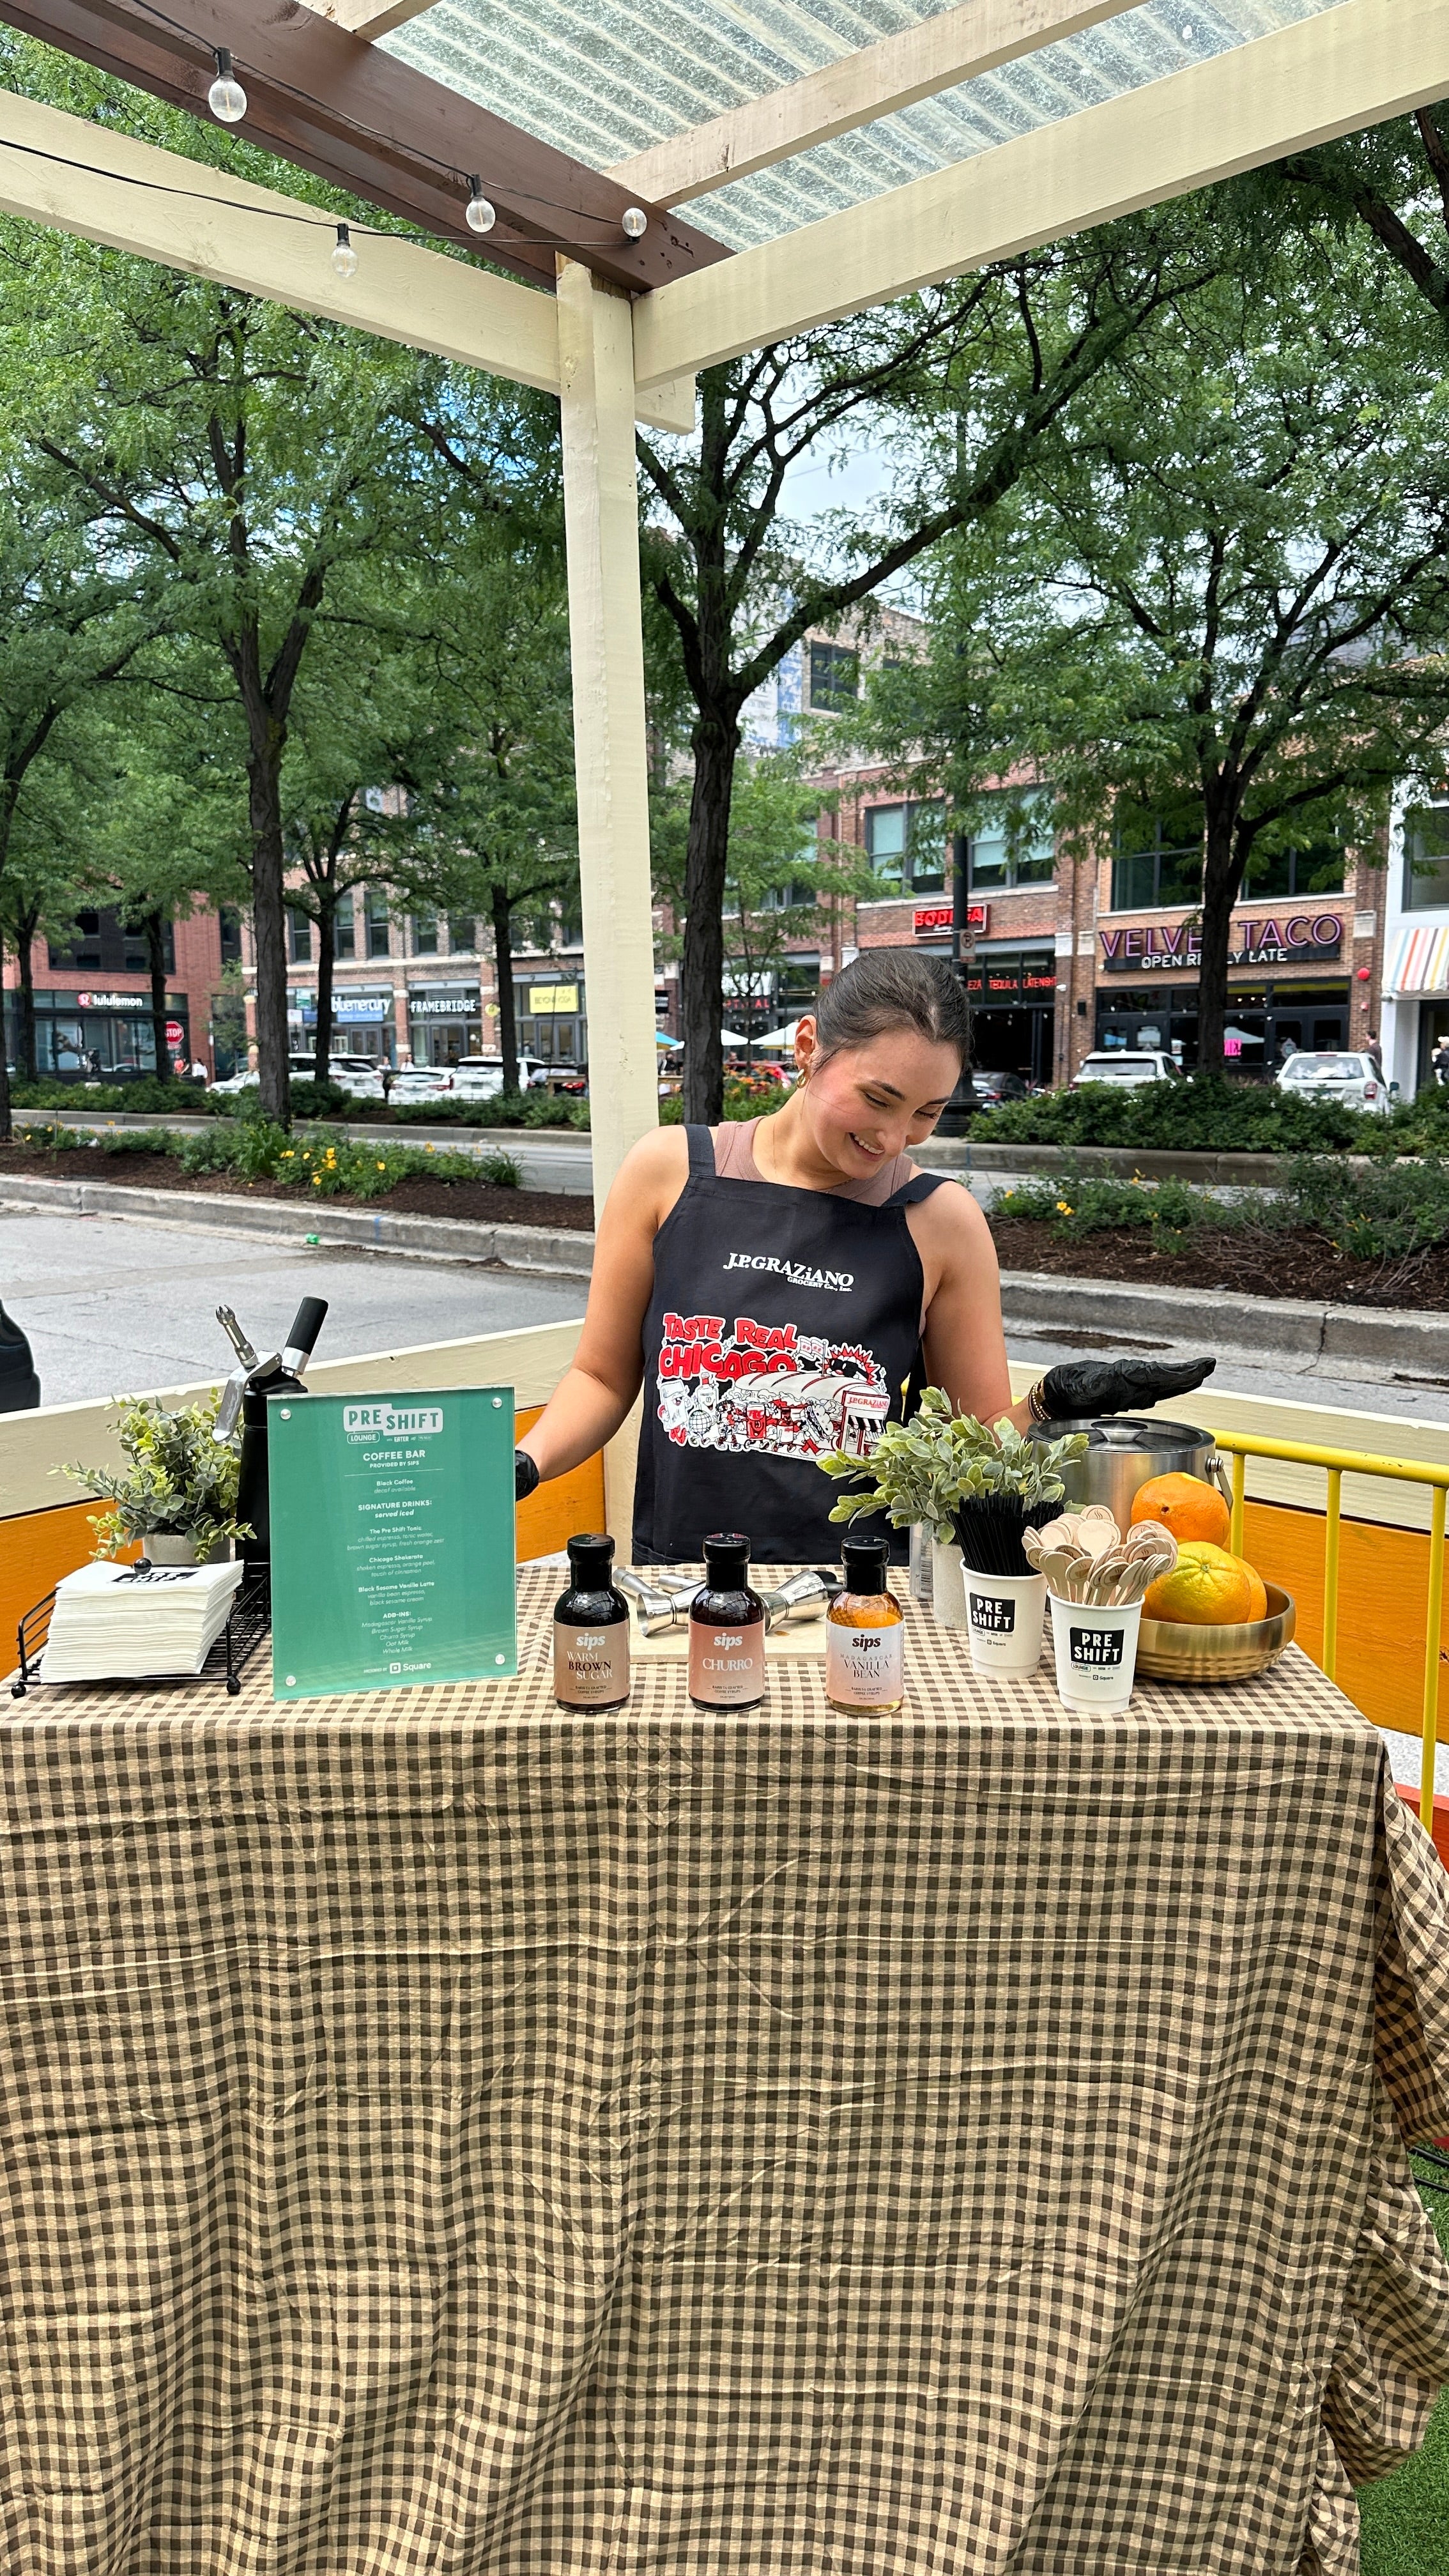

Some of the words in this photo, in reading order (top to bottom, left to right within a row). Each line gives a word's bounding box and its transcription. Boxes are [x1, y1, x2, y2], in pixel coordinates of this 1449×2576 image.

[1099, 924, 1202, 957] VELVE
[1238, 914, 1343, 949] TACO
[1141, 954, 1183, 969] OPEN
[1248, 947, 1288, 963] LATE
[990, 979, 1018, 990] TEQUILA
[93, 995, 143, 1007] lululemon
[331, 996, 392, 1015] bluemercury
[411, 1000, 476, 1013] FRAMEBRIDGE
[787, 1276, 823, 1288] GROCERY
[660, 1343, 797, 1379] CHICAGO
[349, 1409, 381, 1425] PRE
[386, 1413, 438, 1430] SHIFT
[351, 1434, 376, 1442] LOUNGE
[363, 1451, 402, 1461] COFFEE
[406, 1450, 425, 1459] BAR
[358, 1501, 401, 1511] SIGNATURE
[402, 1499, 433, 1508] DRINKS:
[375, 1510, 398, 1519] served
[977, 1598, 1002, 1614] PRE
[973, 1611, 1011, 1629] SHIFT
[576, 1632, 606, 1650] sips
[714, 1632, 743, 1650] sips
[852, 1634, 881, 1652] sips
[1082, 1632, 1112, 1646] PRE
[567, 1651, 598, 1662] WARM
[1074, 1646, 1119, 1662] SHIFT
[403, 1662, 431, 1671] Square
[569, 1660, 611, 1671] BROWN
[703, 1658, 753, 1671] CHURRO
[844, 1659, 889, 1670] VANILLA
[576, 1669, 613, 1680] SUGAR
[854, 1669, 880, 1678] BEAN
